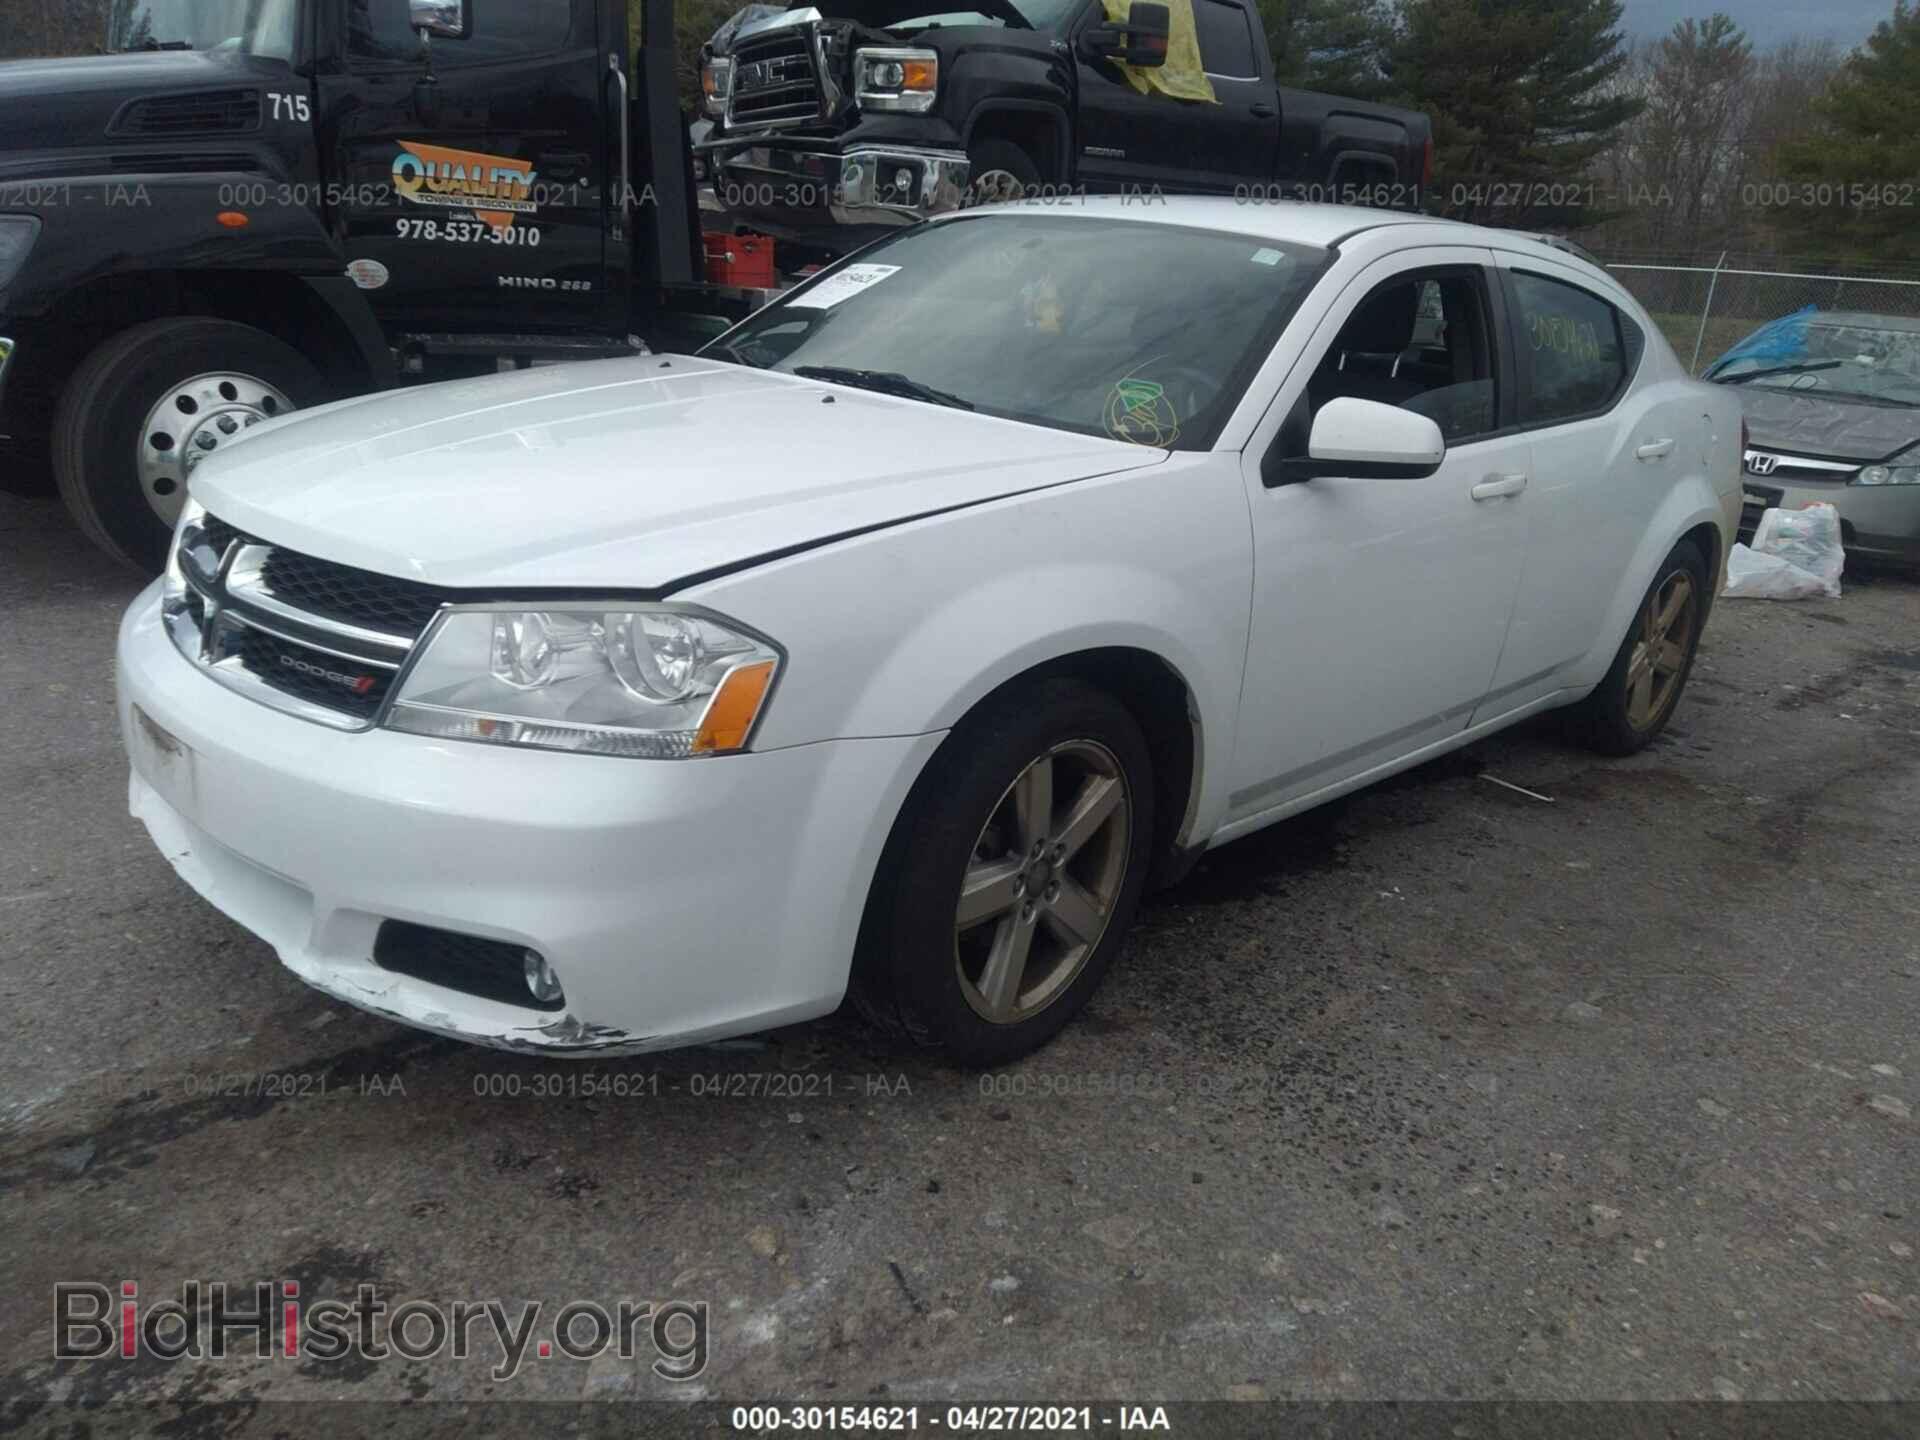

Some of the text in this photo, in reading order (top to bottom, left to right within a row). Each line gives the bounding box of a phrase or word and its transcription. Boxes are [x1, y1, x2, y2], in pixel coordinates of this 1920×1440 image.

[267, 93, 310, 122] 715
[392, 152, 538, 200] QUALITY
[396, 218, 541, 247] 978-537-5010
[498, 276, 557, 289] HINO
[280, 655, 360, 688] DODGE
